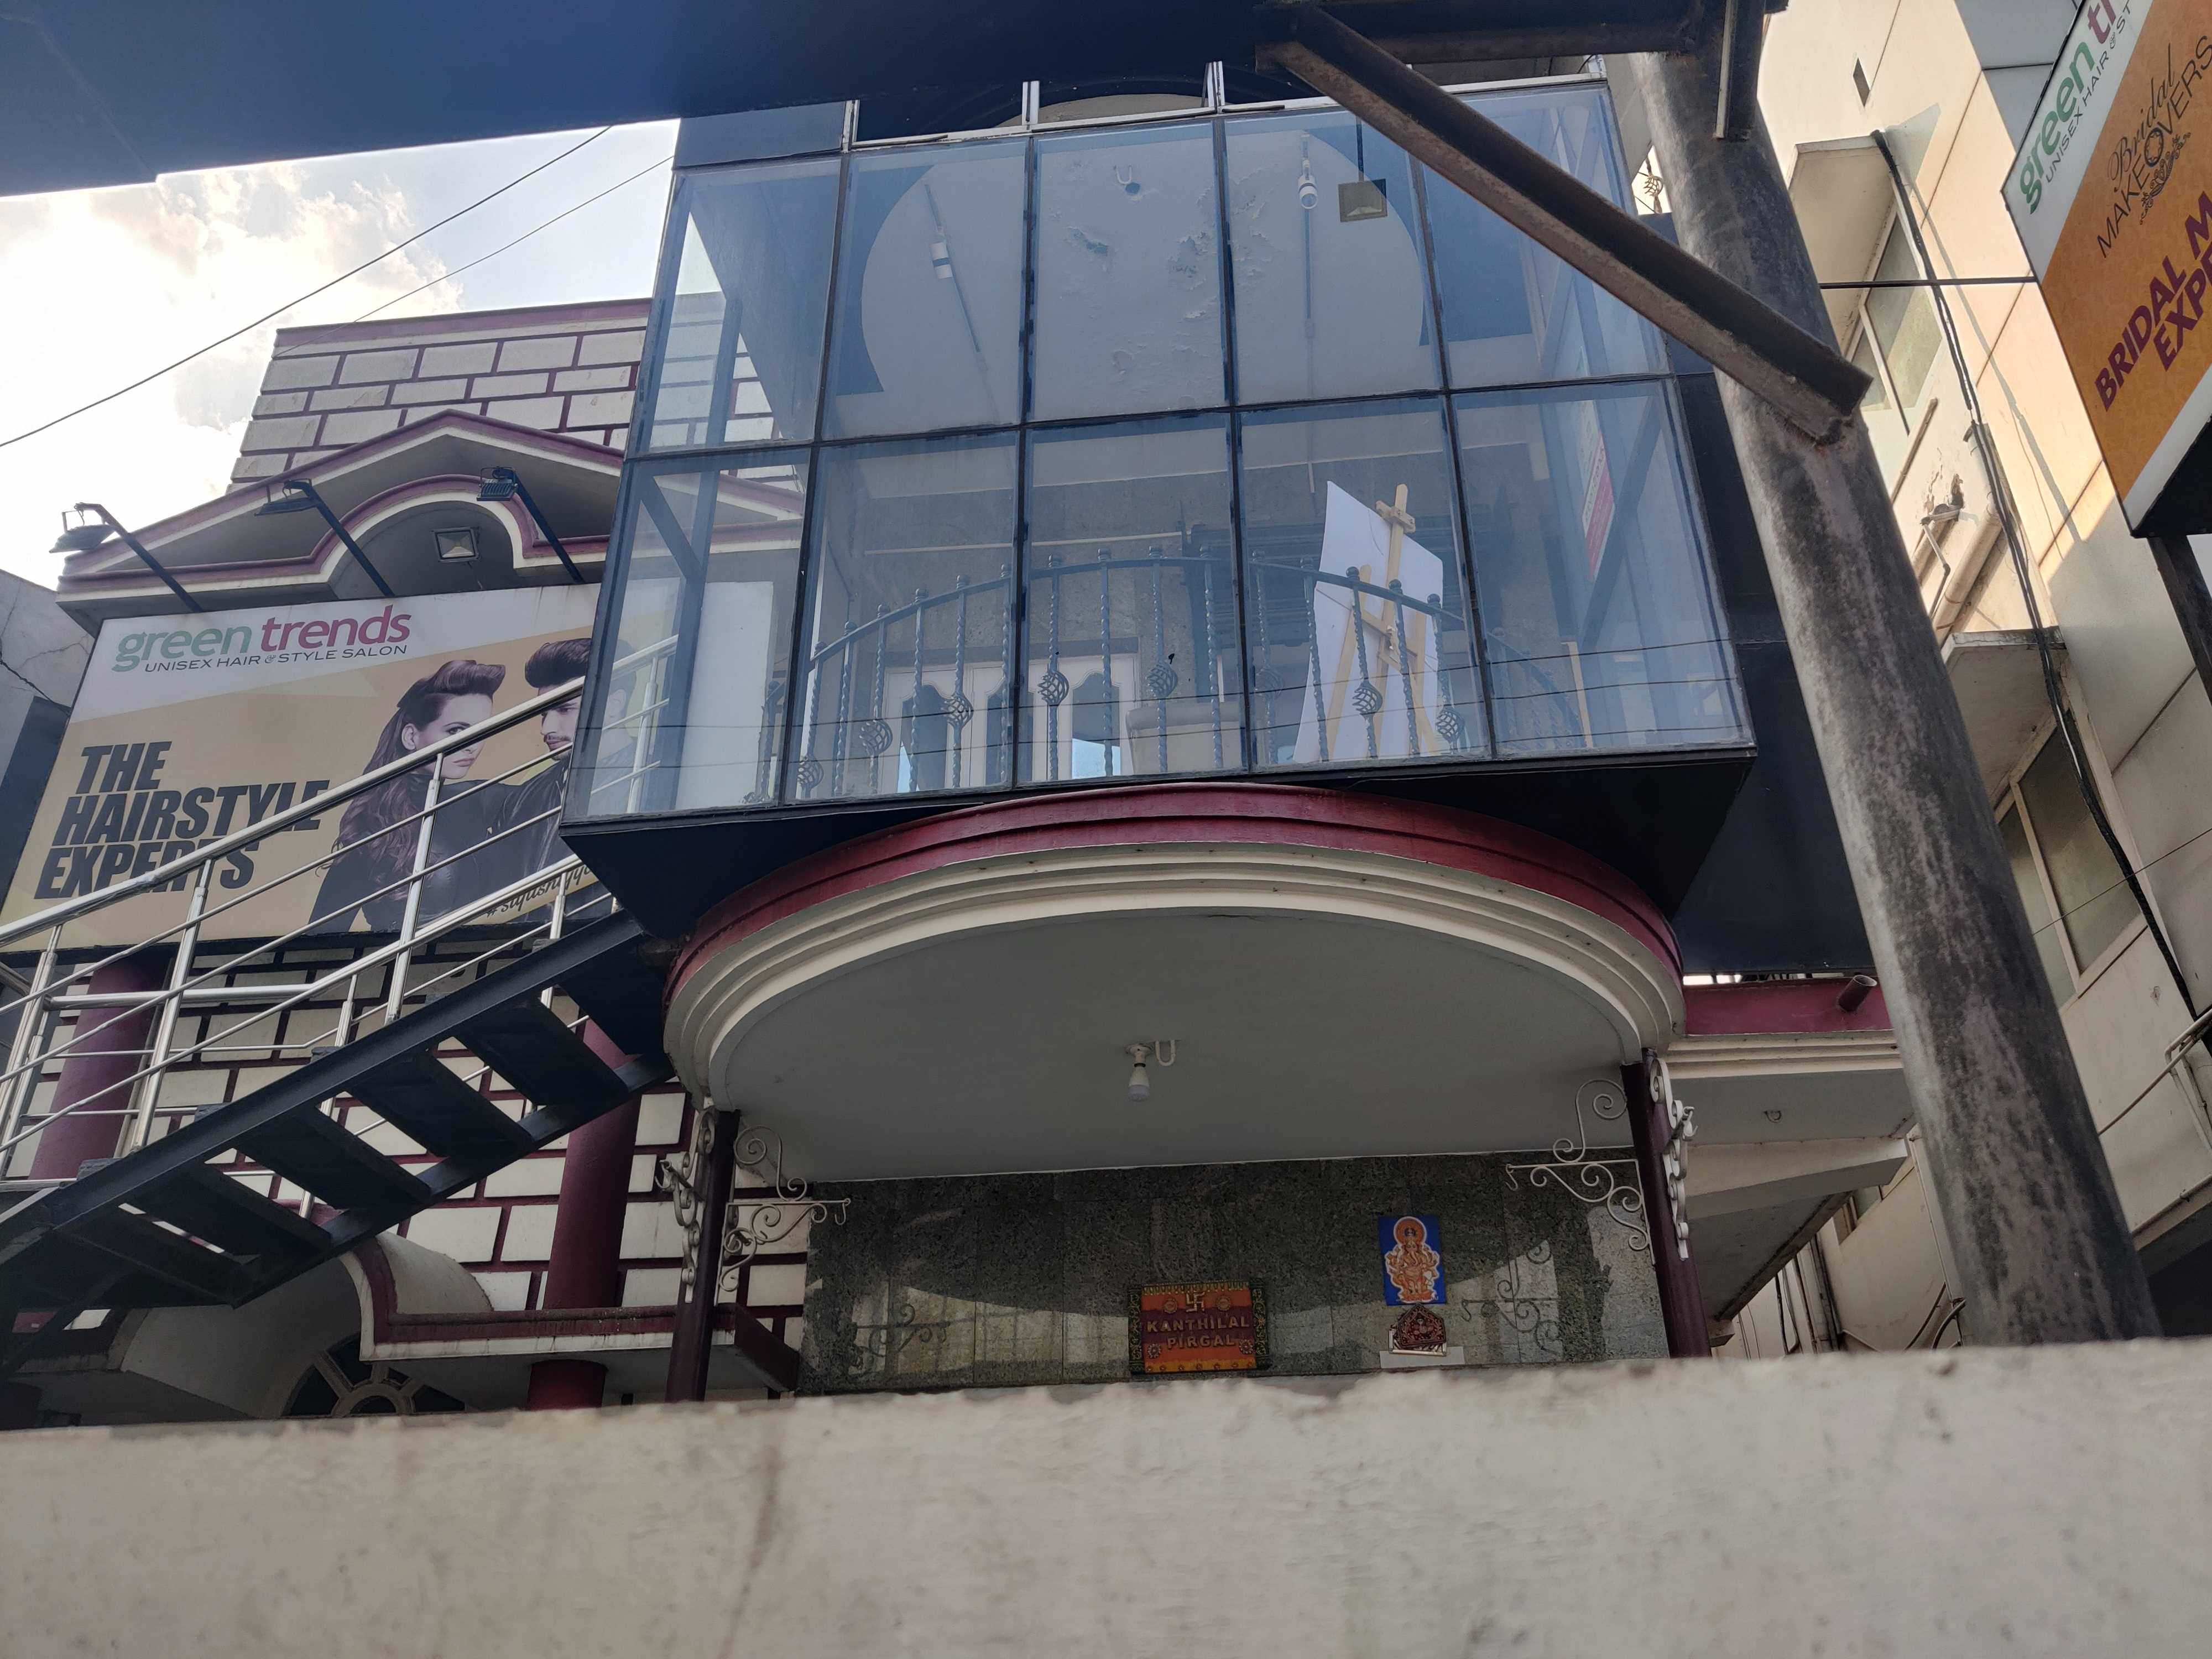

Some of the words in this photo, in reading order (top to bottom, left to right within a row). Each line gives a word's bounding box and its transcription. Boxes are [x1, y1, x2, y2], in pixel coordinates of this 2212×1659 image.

[2020, 41, 2095, 214] green
[2046, 106, 2083, 183] UNISEX
[2082, 50, 2109, 107] HAIR
[2097, 35, 2212, 258] MAKEOVERS
[2107, 43, 2176, 192] Bridal
[2095, 255, 2187, 412] BRIDAL
[111, 626, 252, 672] green
[260, 604, 412, 652] trends
[145, 659, 212, 673] UNISEX
[216, 655, 261, 668] HAIR
[278, 650, 338, 663] STYLE
[342, 644, 408, 659] SALON
[76, 741, 172, 794] THE
[52, 780, 330, 851] HAIRSTYLE
[1146, 1315, 1250, 1333] KANTHILAL
[1167, 1333, 1235, 1350] PIRGAL
